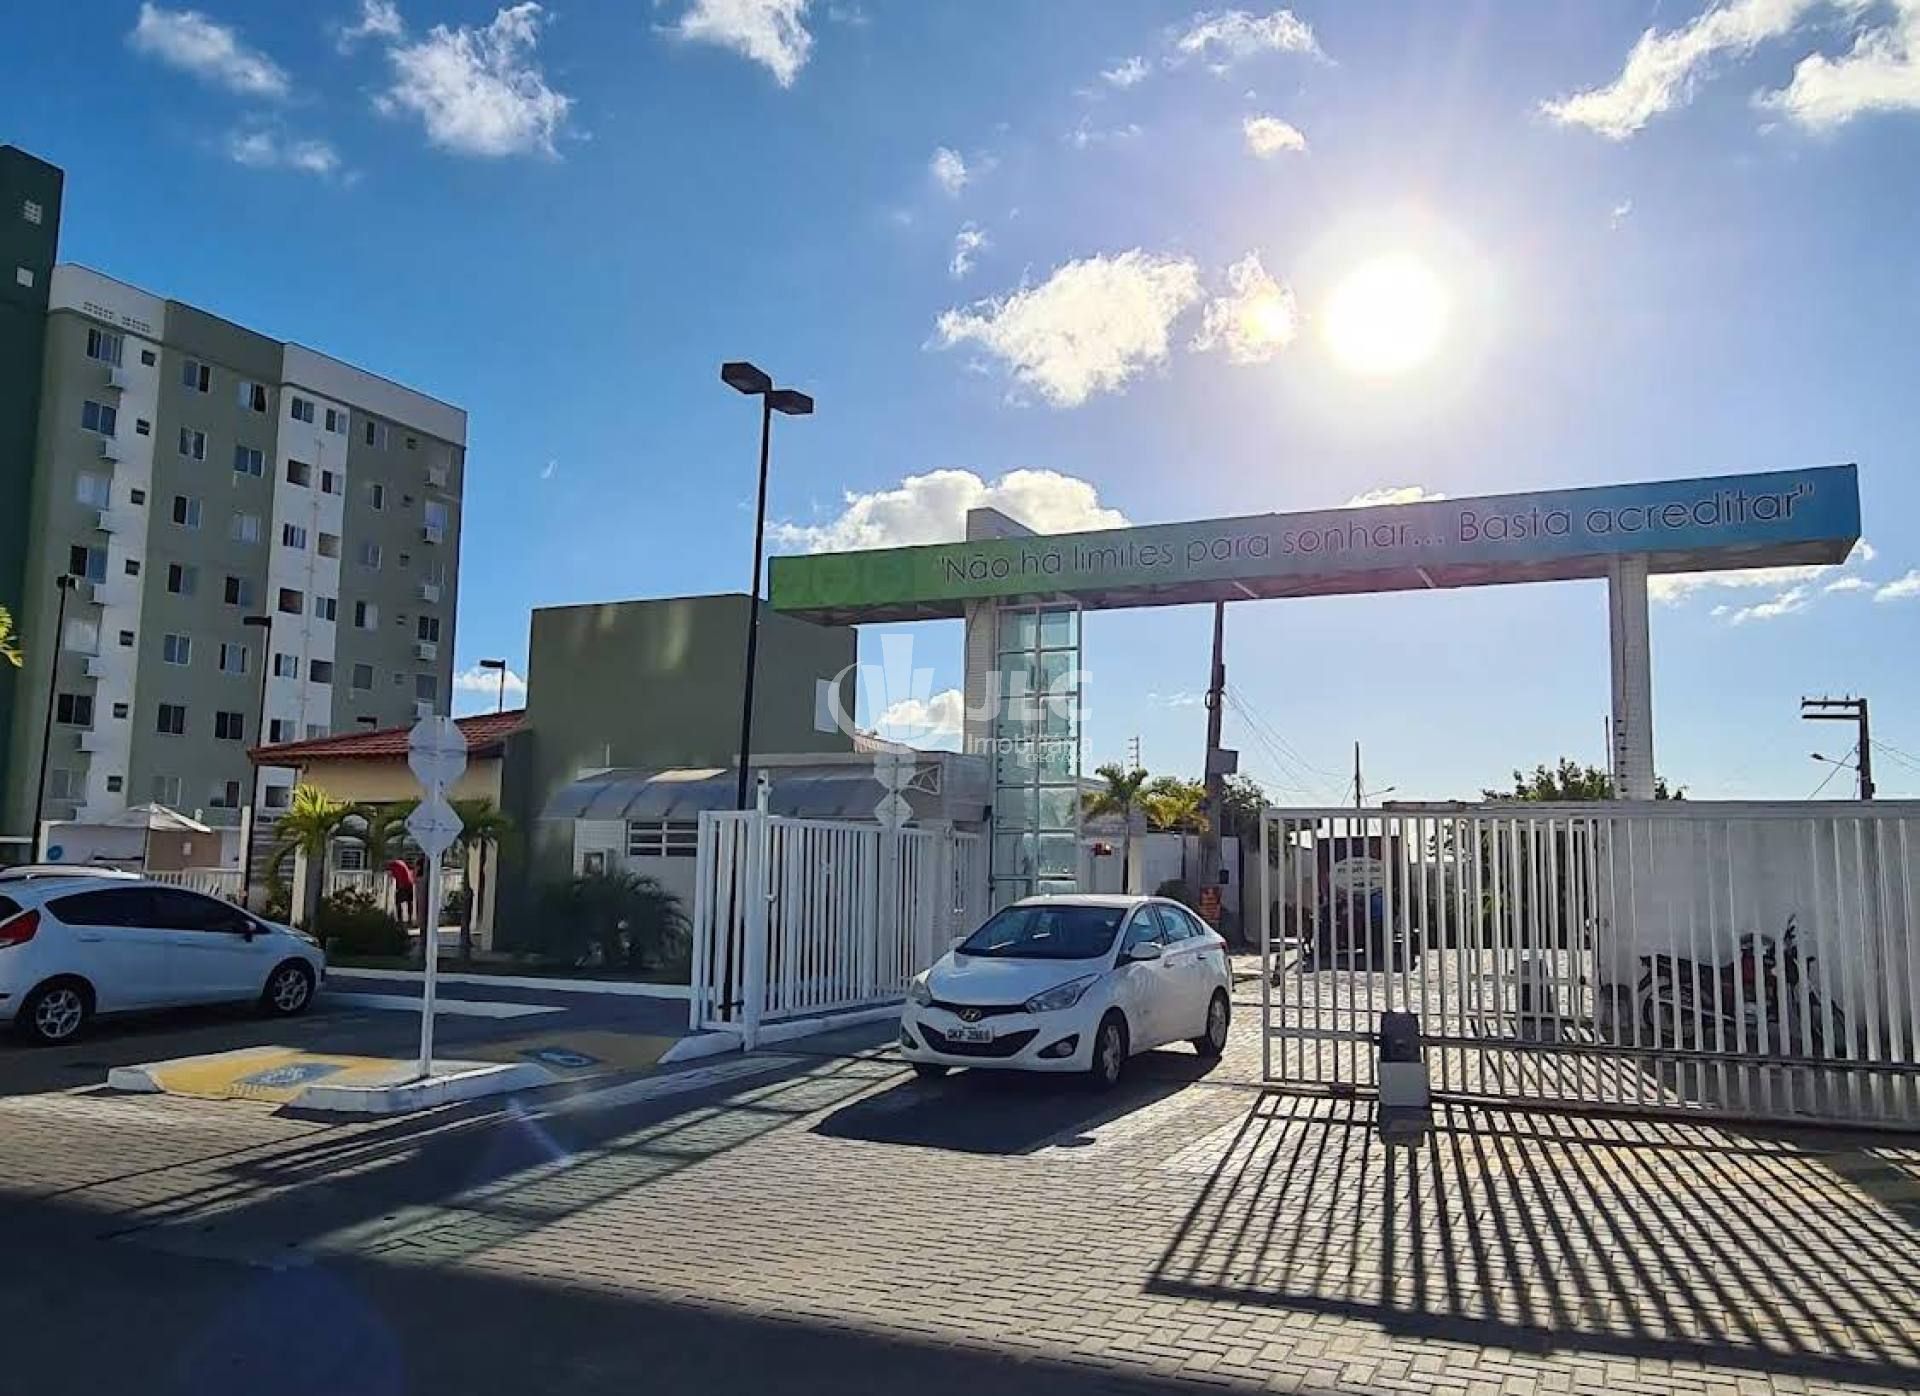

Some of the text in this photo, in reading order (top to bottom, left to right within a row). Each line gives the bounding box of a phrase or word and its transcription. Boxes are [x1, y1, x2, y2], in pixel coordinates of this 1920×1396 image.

[1021, 546, 1061, 575] há
[1074, 541, 1173, 571] limites
[1187, 535, 1269, 569] para
[1282, 520, 1443, 553] sonhar...
[1460, 507, 1571, 542] Basta
[1585, 482, 1814, 533] acreditar"
